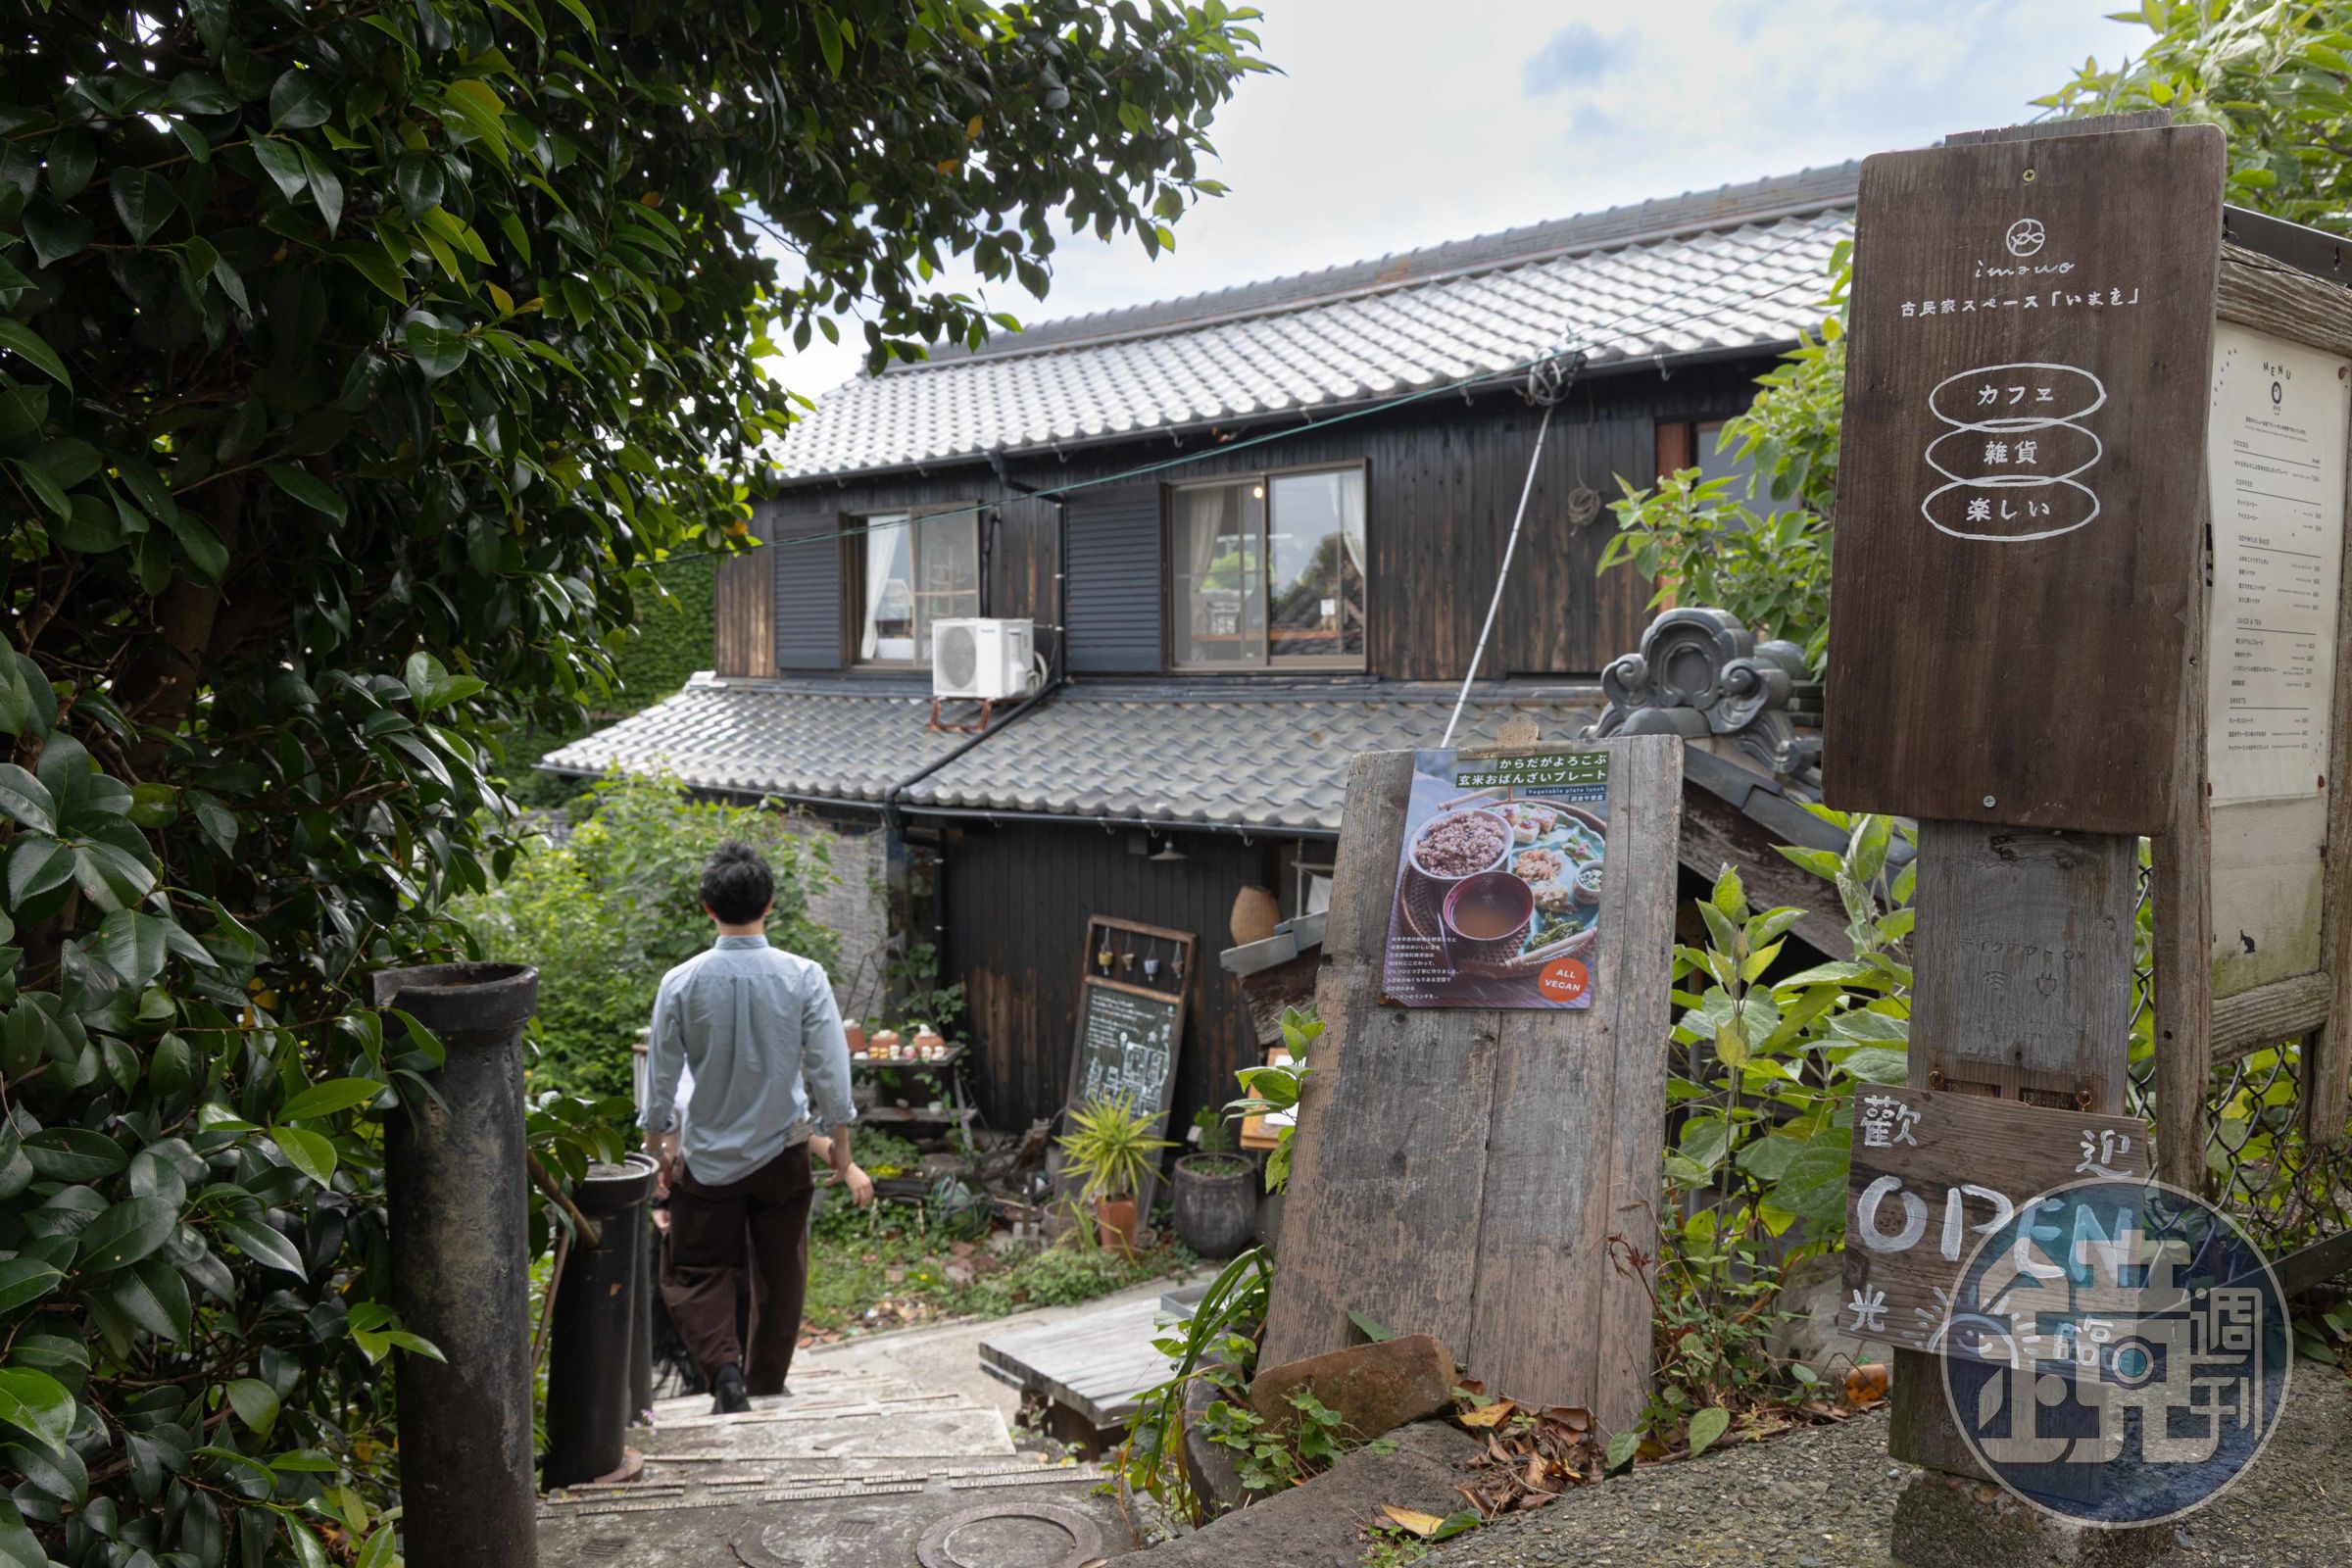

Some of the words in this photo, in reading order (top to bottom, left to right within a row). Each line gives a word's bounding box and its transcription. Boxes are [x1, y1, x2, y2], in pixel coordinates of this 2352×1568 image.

[2263, 361, 2292, 380] MENU
[1983, 440, 2038, 466] 雑貨
[1965, 497, 2051, 522] 楽しい
[1498, 754, 1608, 769] からだがよろこぶ
[1457, 769, 1607, 786] 玄米おばんざいプレート
[1555, 968, 1576, 979] ALL
[1544, 979, 1581, 992] VEGAN
[1860, 1095, 1922, 1149] 歡
[2075, 1129, 2134, 1178] 迎
[1857, 1174, 2134, 1287] OPEN
[1847, 1283, 1889, 1333] 光
